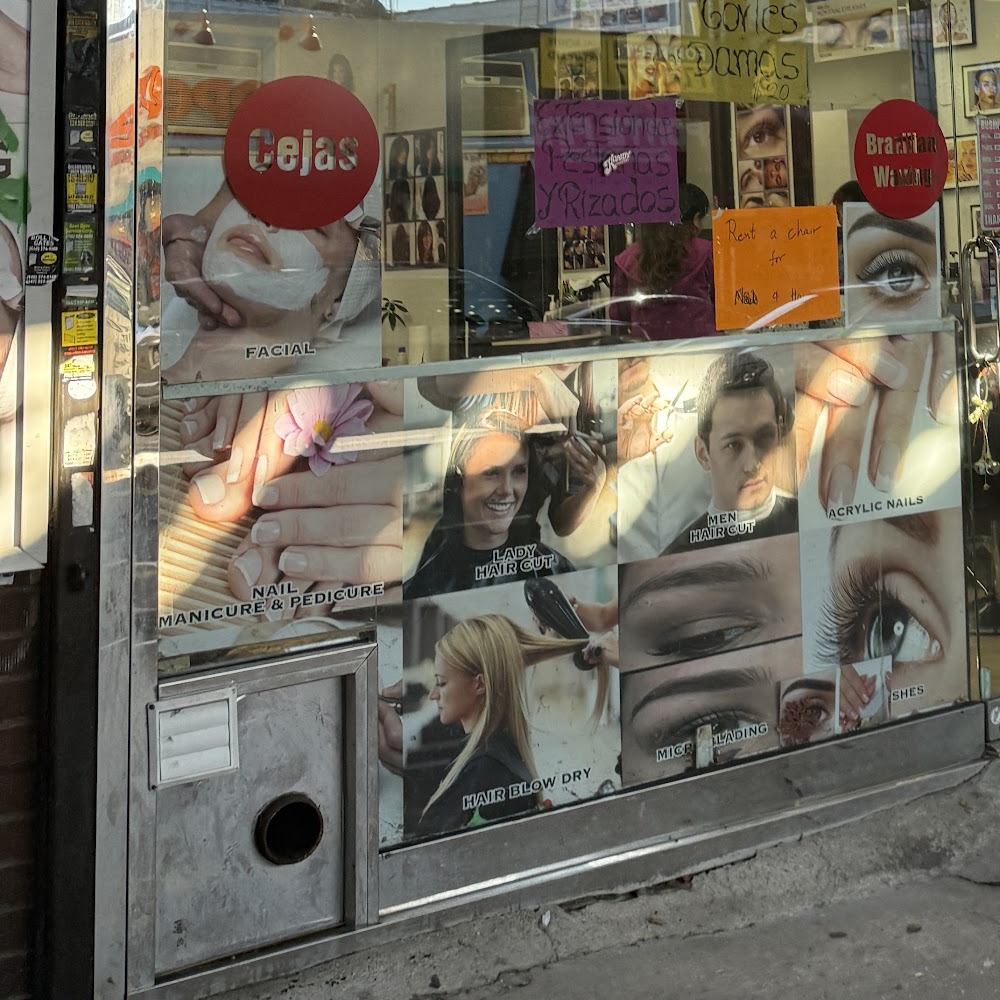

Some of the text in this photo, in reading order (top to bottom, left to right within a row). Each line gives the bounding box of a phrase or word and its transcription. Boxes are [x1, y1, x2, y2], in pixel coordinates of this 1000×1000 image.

[248, 128, 359, 177] Cejas
[865, 131, 937, 156] Brazilian
[872, 165, 932, 189] Waxing
[726, 218, 756, 242] Rent
[245, 342, 316, 360] FACIAL
[707, 510, 738, 527] MEN
[828, 495, 924, 519] ACRYLIC NAILS
[689, 518, 756, 544] HAIR CUT
[492, 543, 537, 564] LADY
[475, 554, 555, 581] HAIR CUT
[251, 581, 298, 599] NAIL
[159, 582, 385, 629] MANICURE & PEDICURE
[892, 685, 925, 702] SHES
[462, 767, 592, 811] HAIR BLOW DRY
